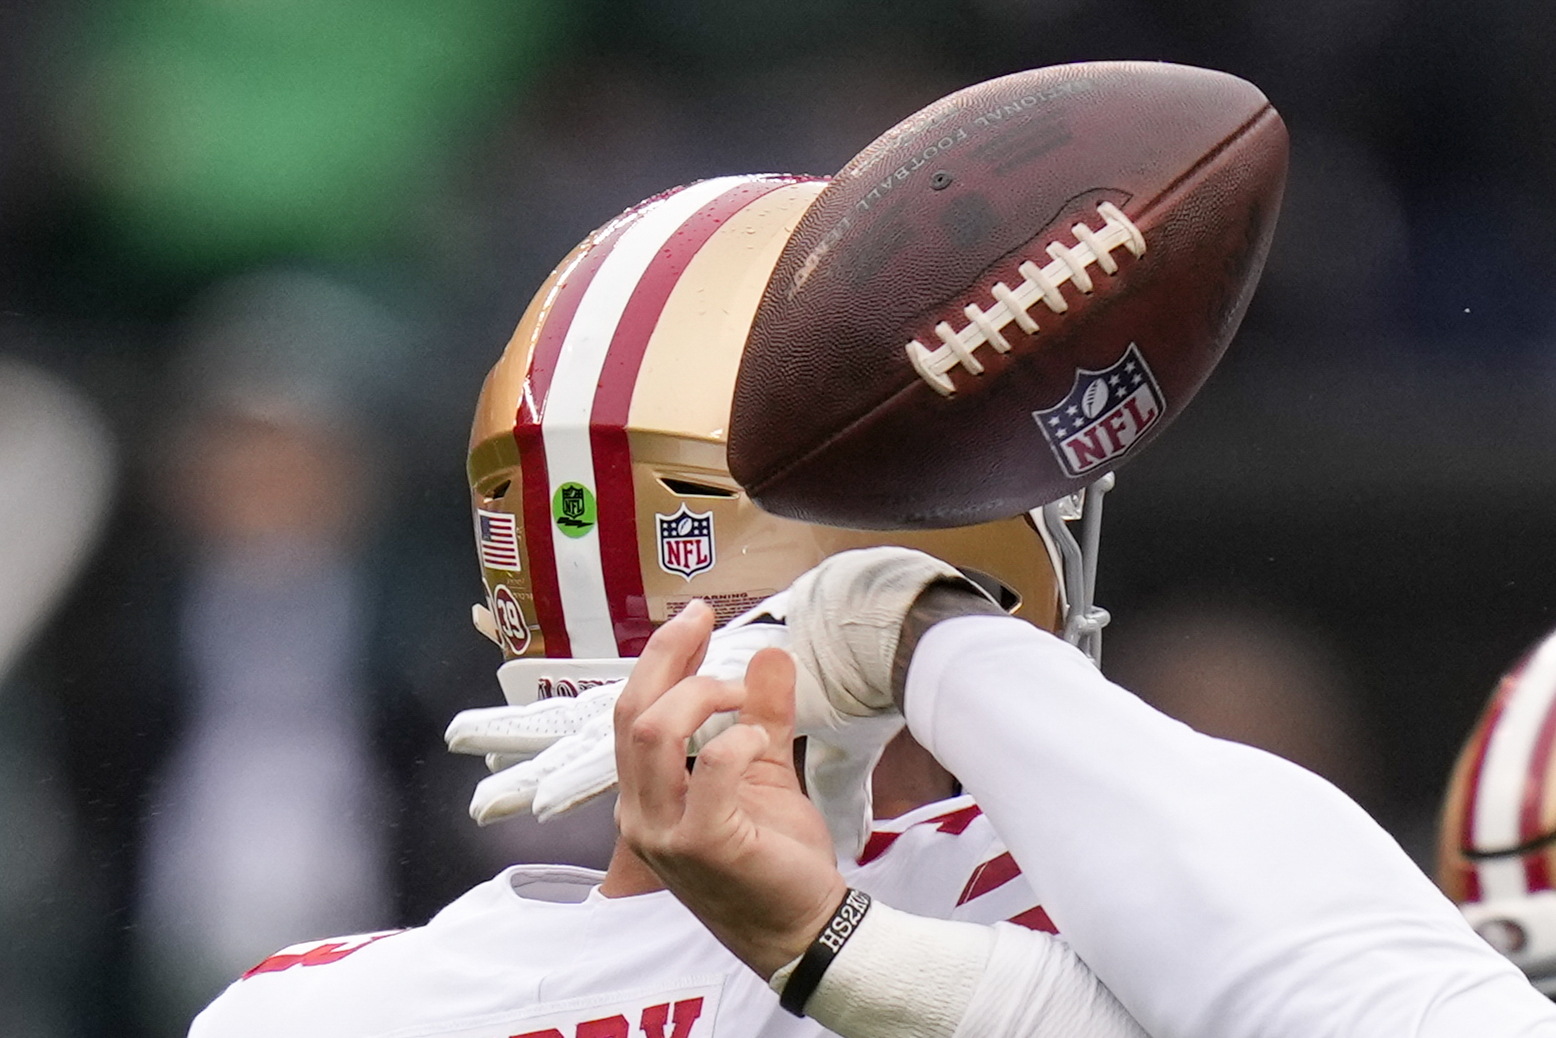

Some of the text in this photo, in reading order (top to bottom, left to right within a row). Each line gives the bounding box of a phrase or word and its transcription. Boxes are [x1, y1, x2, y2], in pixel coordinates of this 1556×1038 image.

[854, 127, 967, 214] FOOTBALL
[1066, 395, 1157, 470] NFL
[563, 498, 583, 515] NFL
[666, 539, 708, 569] NFL
[497, 598, 526, 640] 39
[819, 889, 870, 954] HS2K
